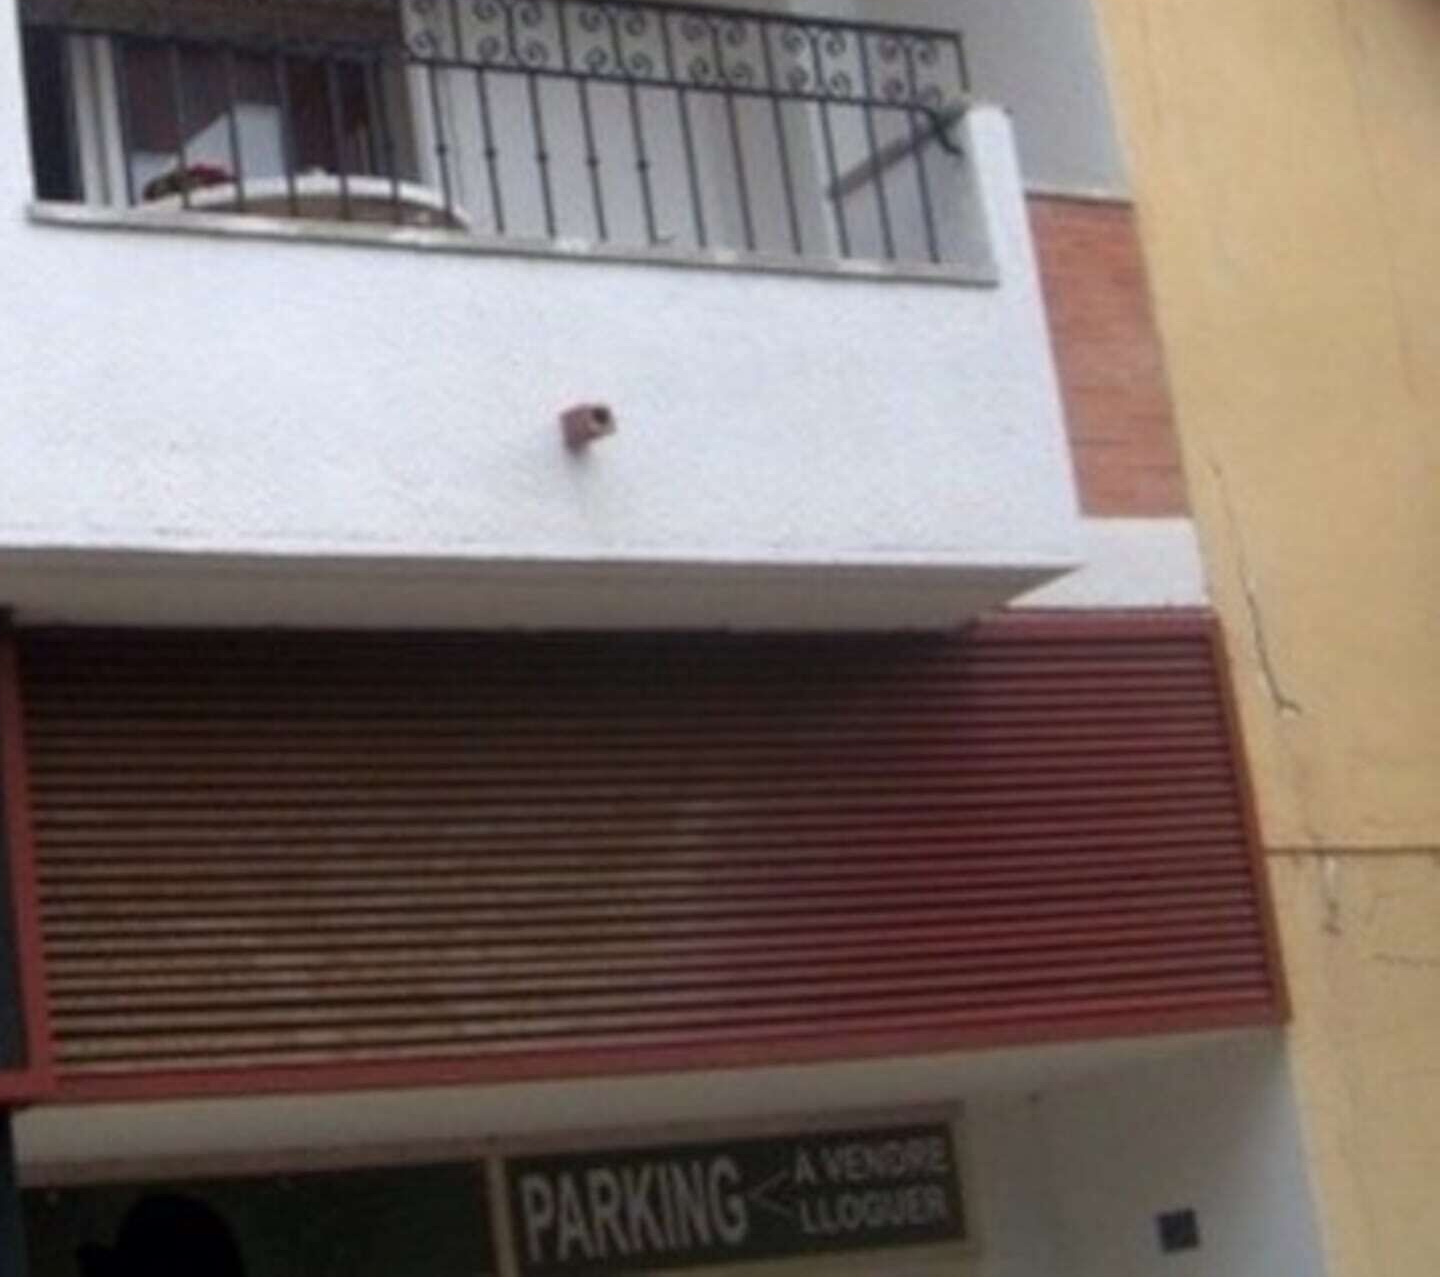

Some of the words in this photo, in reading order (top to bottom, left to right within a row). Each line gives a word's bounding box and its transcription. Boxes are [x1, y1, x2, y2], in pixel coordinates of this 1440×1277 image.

[819, 1135, 948, 1182] VENDRE
[520, 1154, 749, 1263] PARKING
[800, 1185, 949, 1235] LLOGUER
